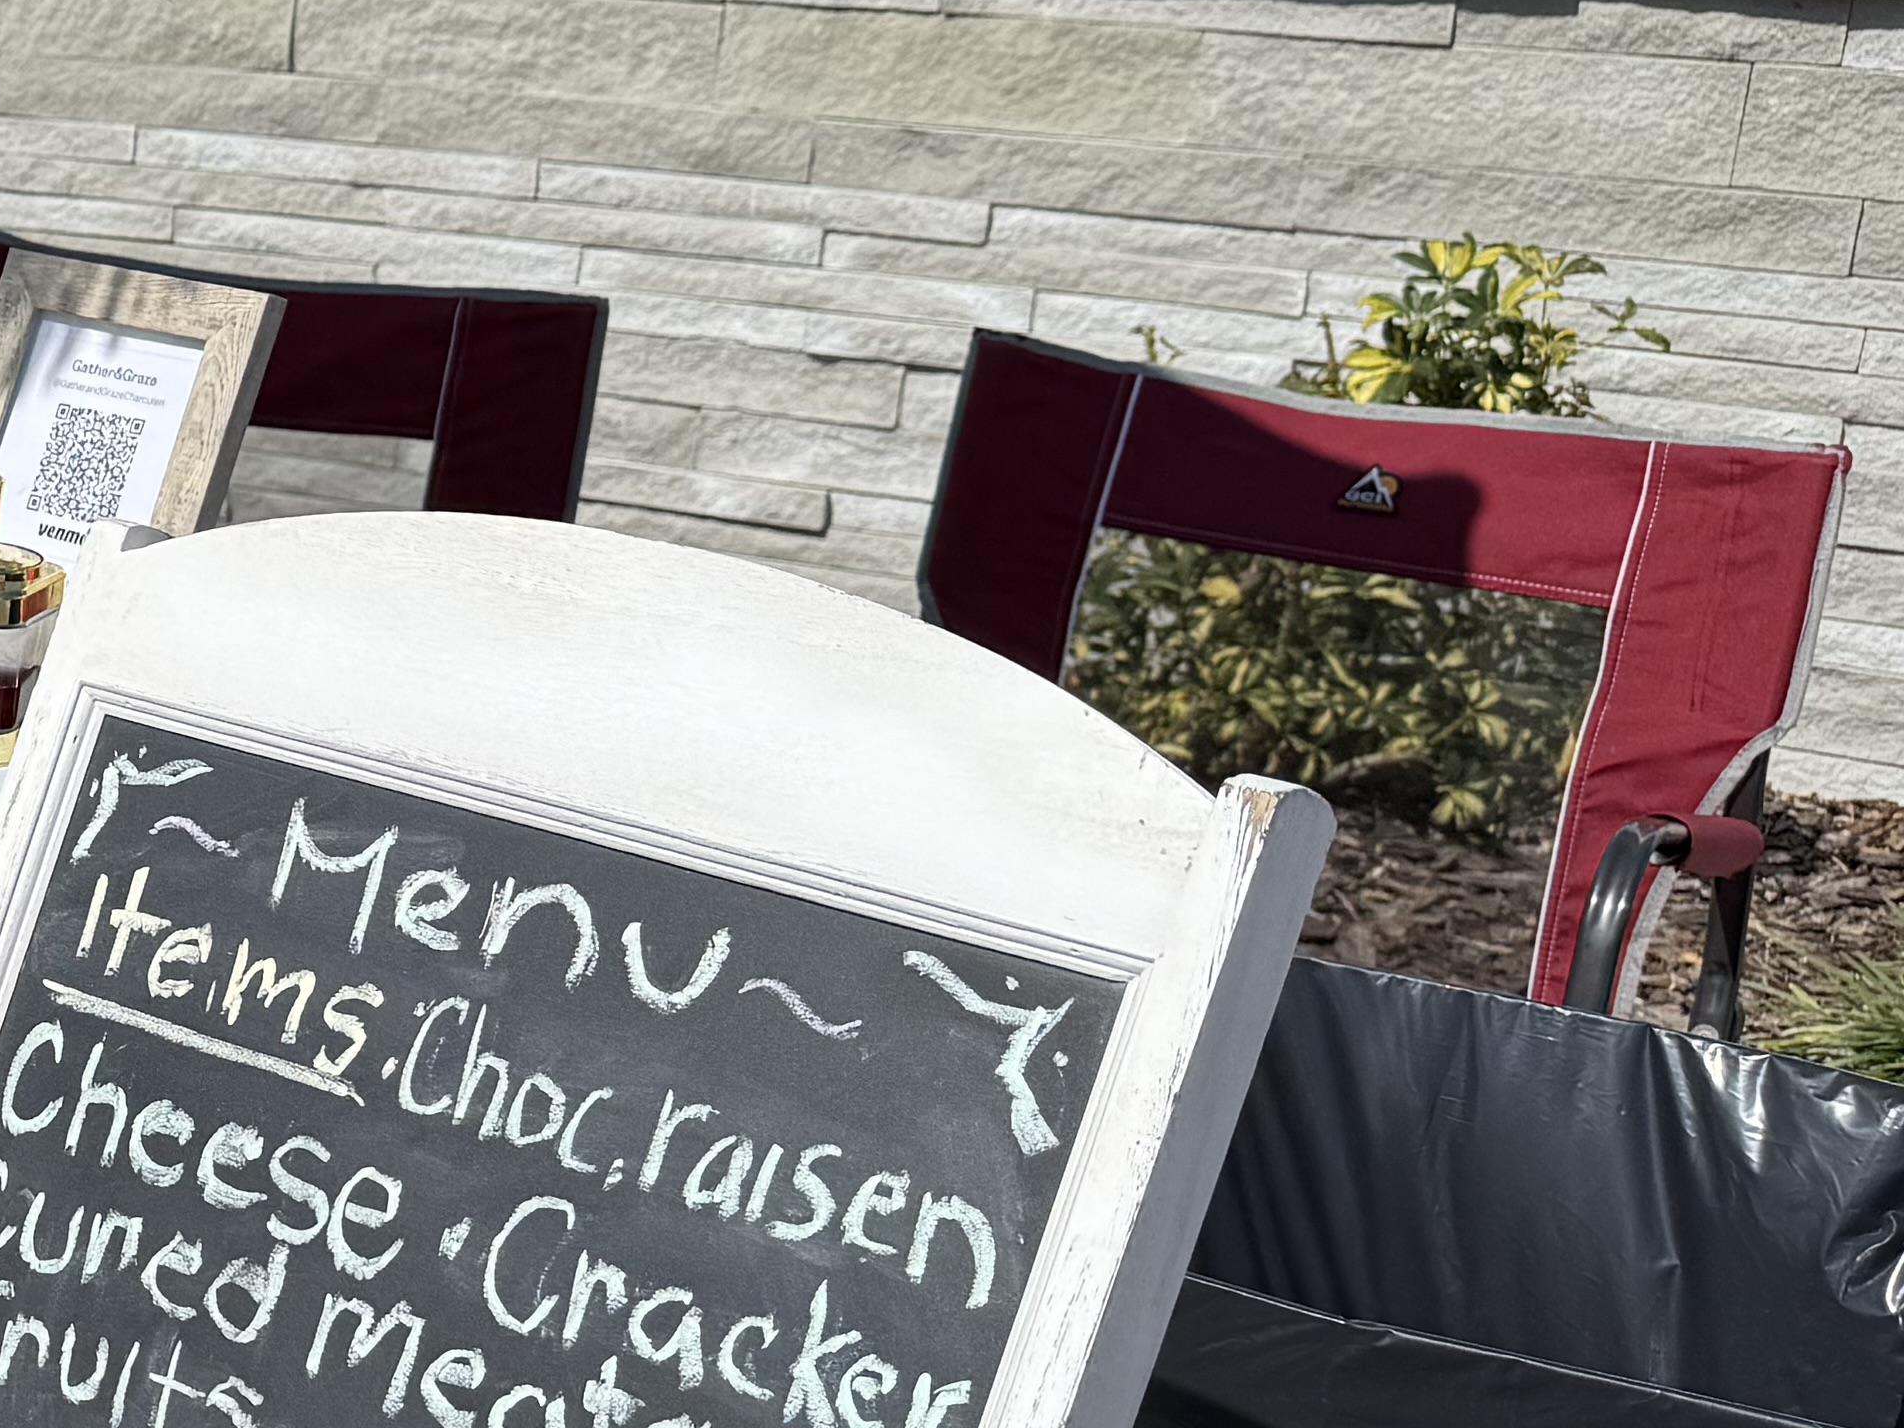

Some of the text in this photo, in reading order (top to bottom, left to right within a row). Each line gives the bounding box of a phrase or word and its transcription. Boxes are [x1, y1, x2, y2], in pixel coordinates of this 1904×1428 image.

[74, 866, 387, 1079] Items
[267, 796, 733, 1014] Menu
[1, 1018, 405, 1280] Cheese
